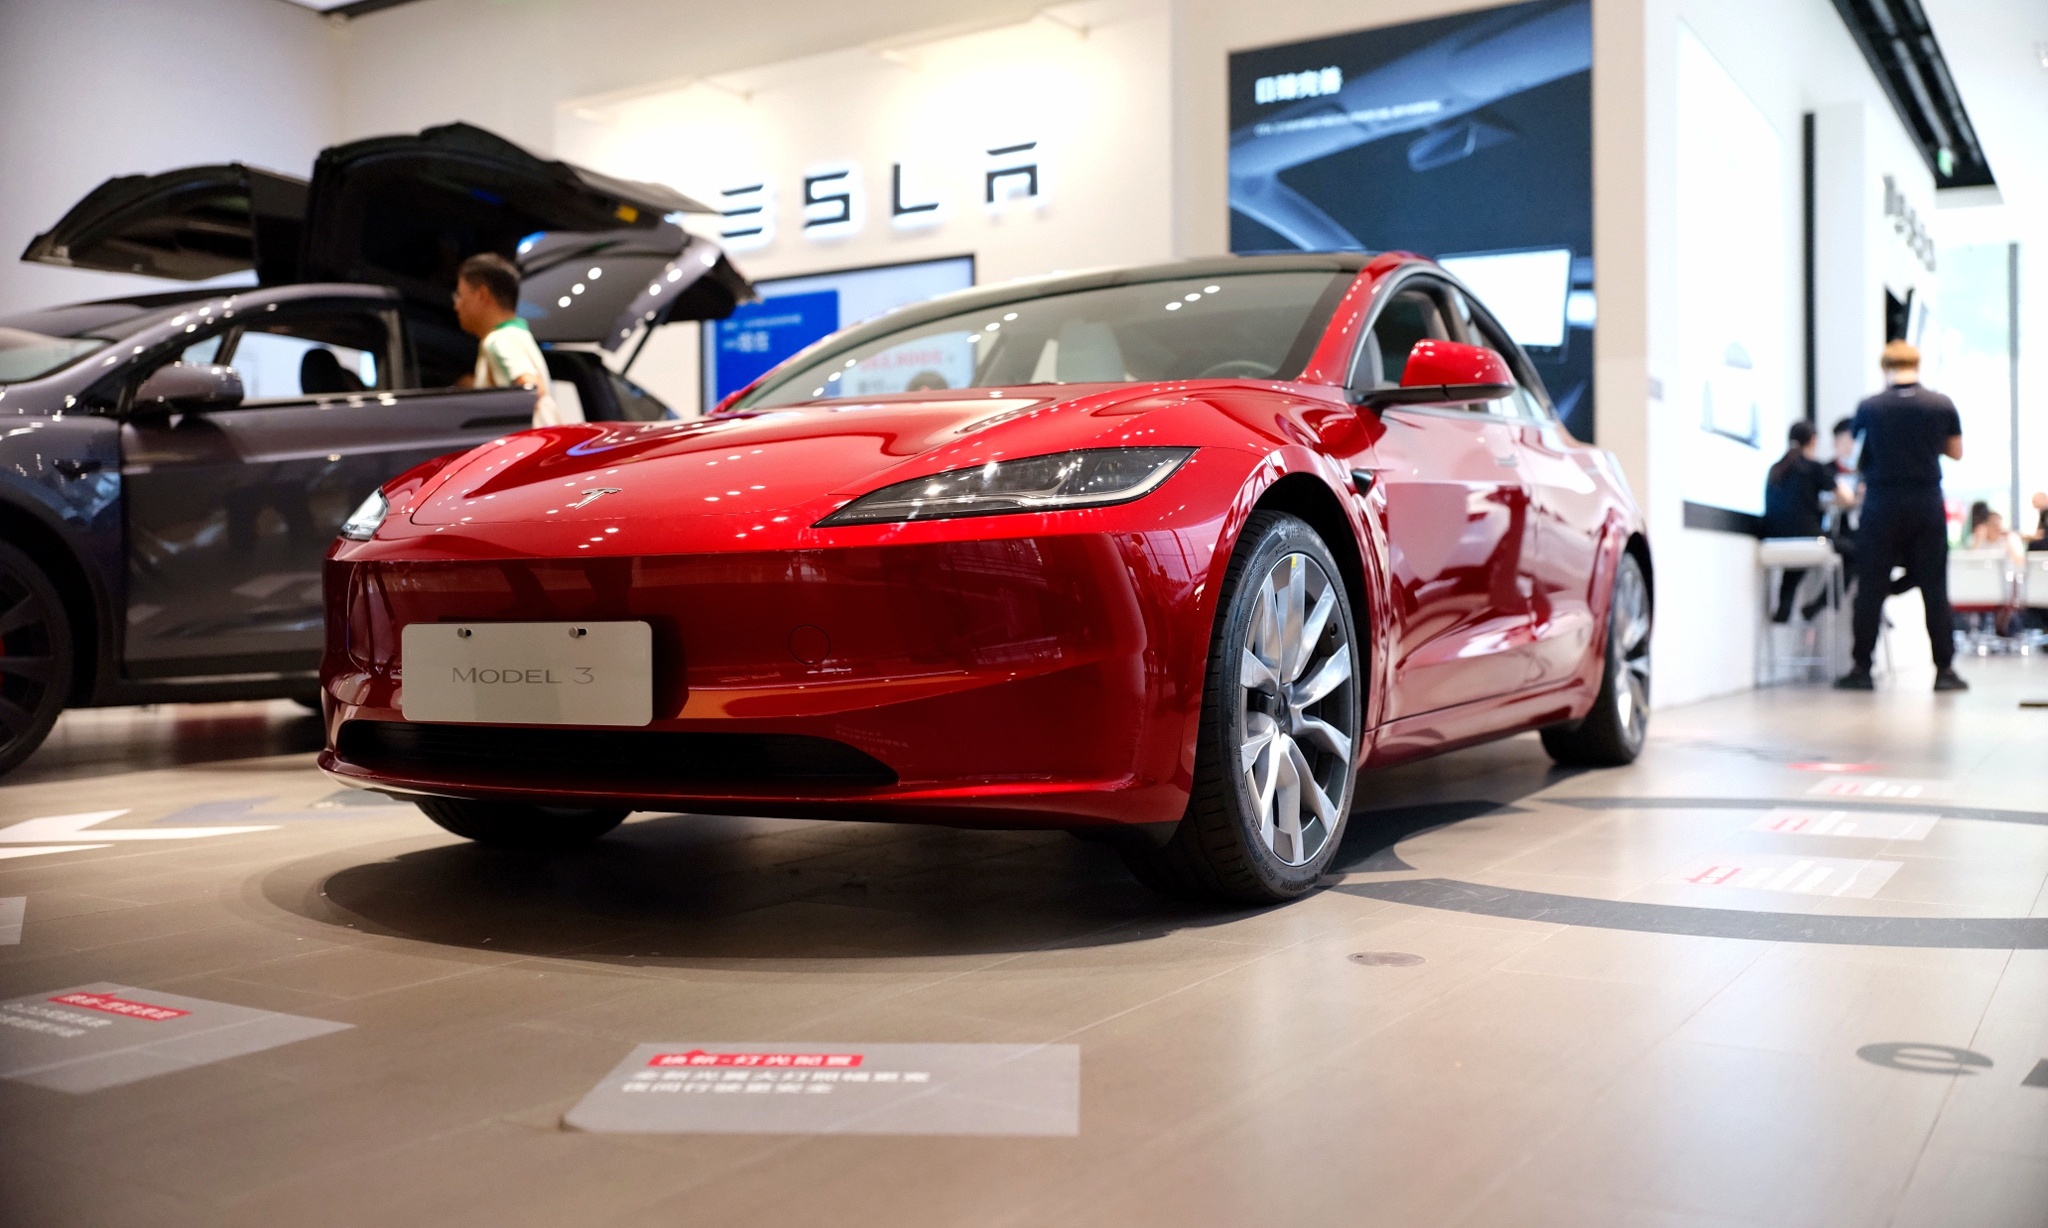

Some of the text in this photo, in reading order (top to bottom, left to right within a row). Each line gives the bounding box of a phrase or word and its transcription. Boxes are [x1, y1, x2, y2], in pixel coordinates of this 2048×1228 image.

[720, 142, 1037, 238] ESLA
[452, 666, 595, 684] MODEL 3
